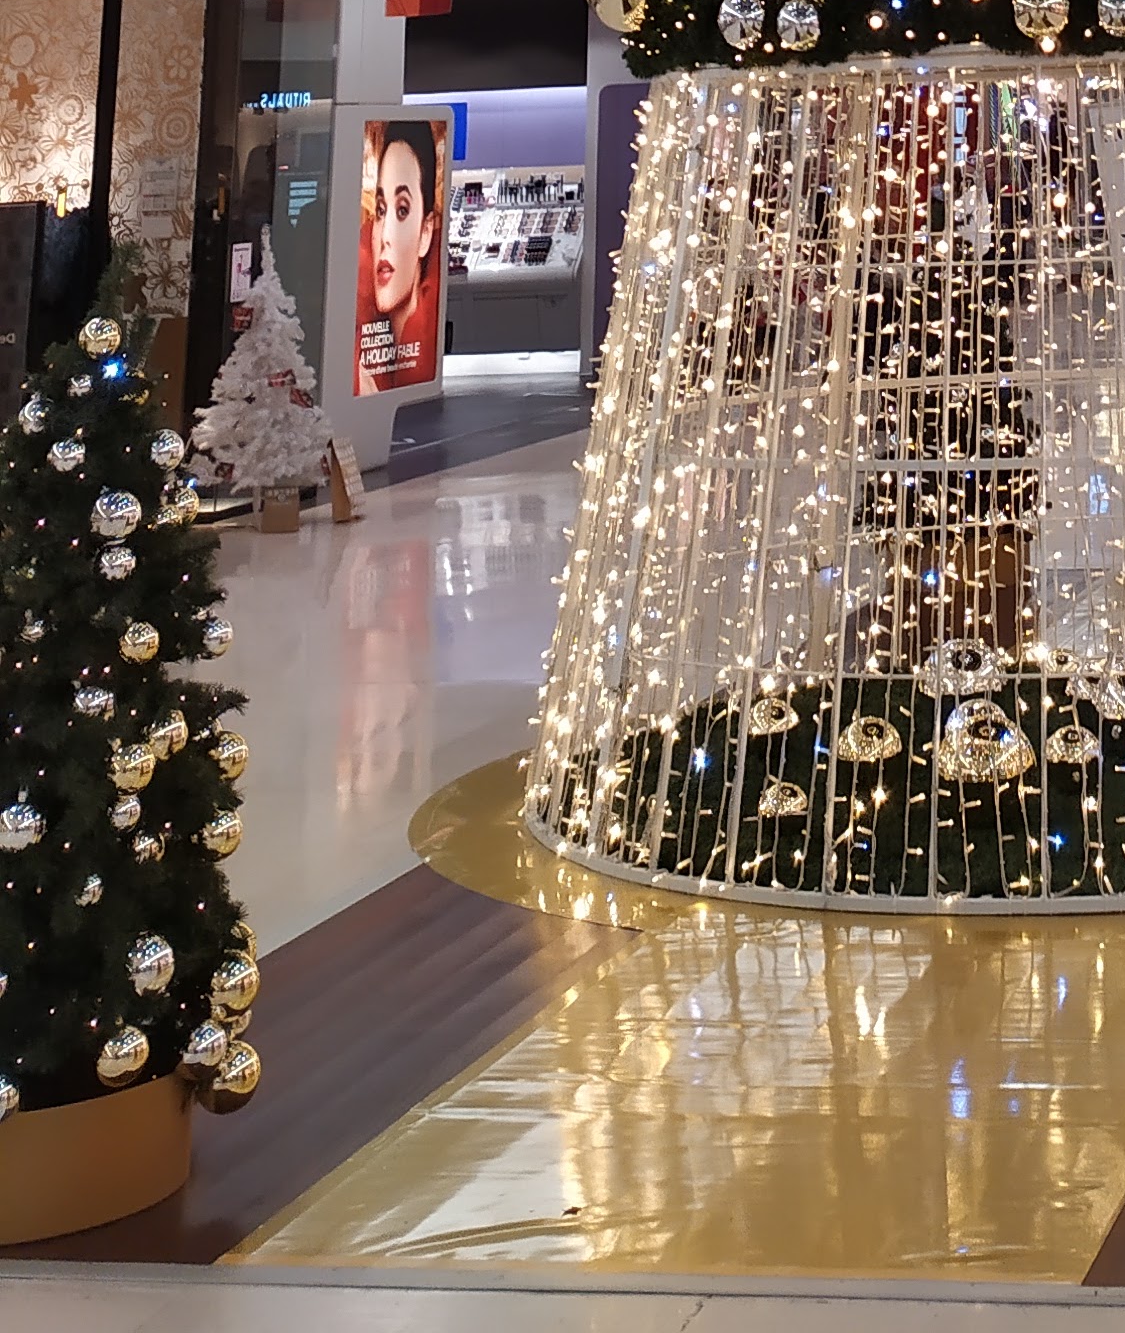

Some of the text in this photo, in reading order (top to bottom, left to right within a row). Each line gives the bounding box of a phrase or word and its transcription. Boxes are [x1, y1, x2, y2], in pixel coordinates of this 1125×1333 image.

[361, 320, 390, 335] NOUVELLE
[361, 334, 393, 349] COLLECTION
[360, 341, 421, 366] A HOLIDAY FABLE
